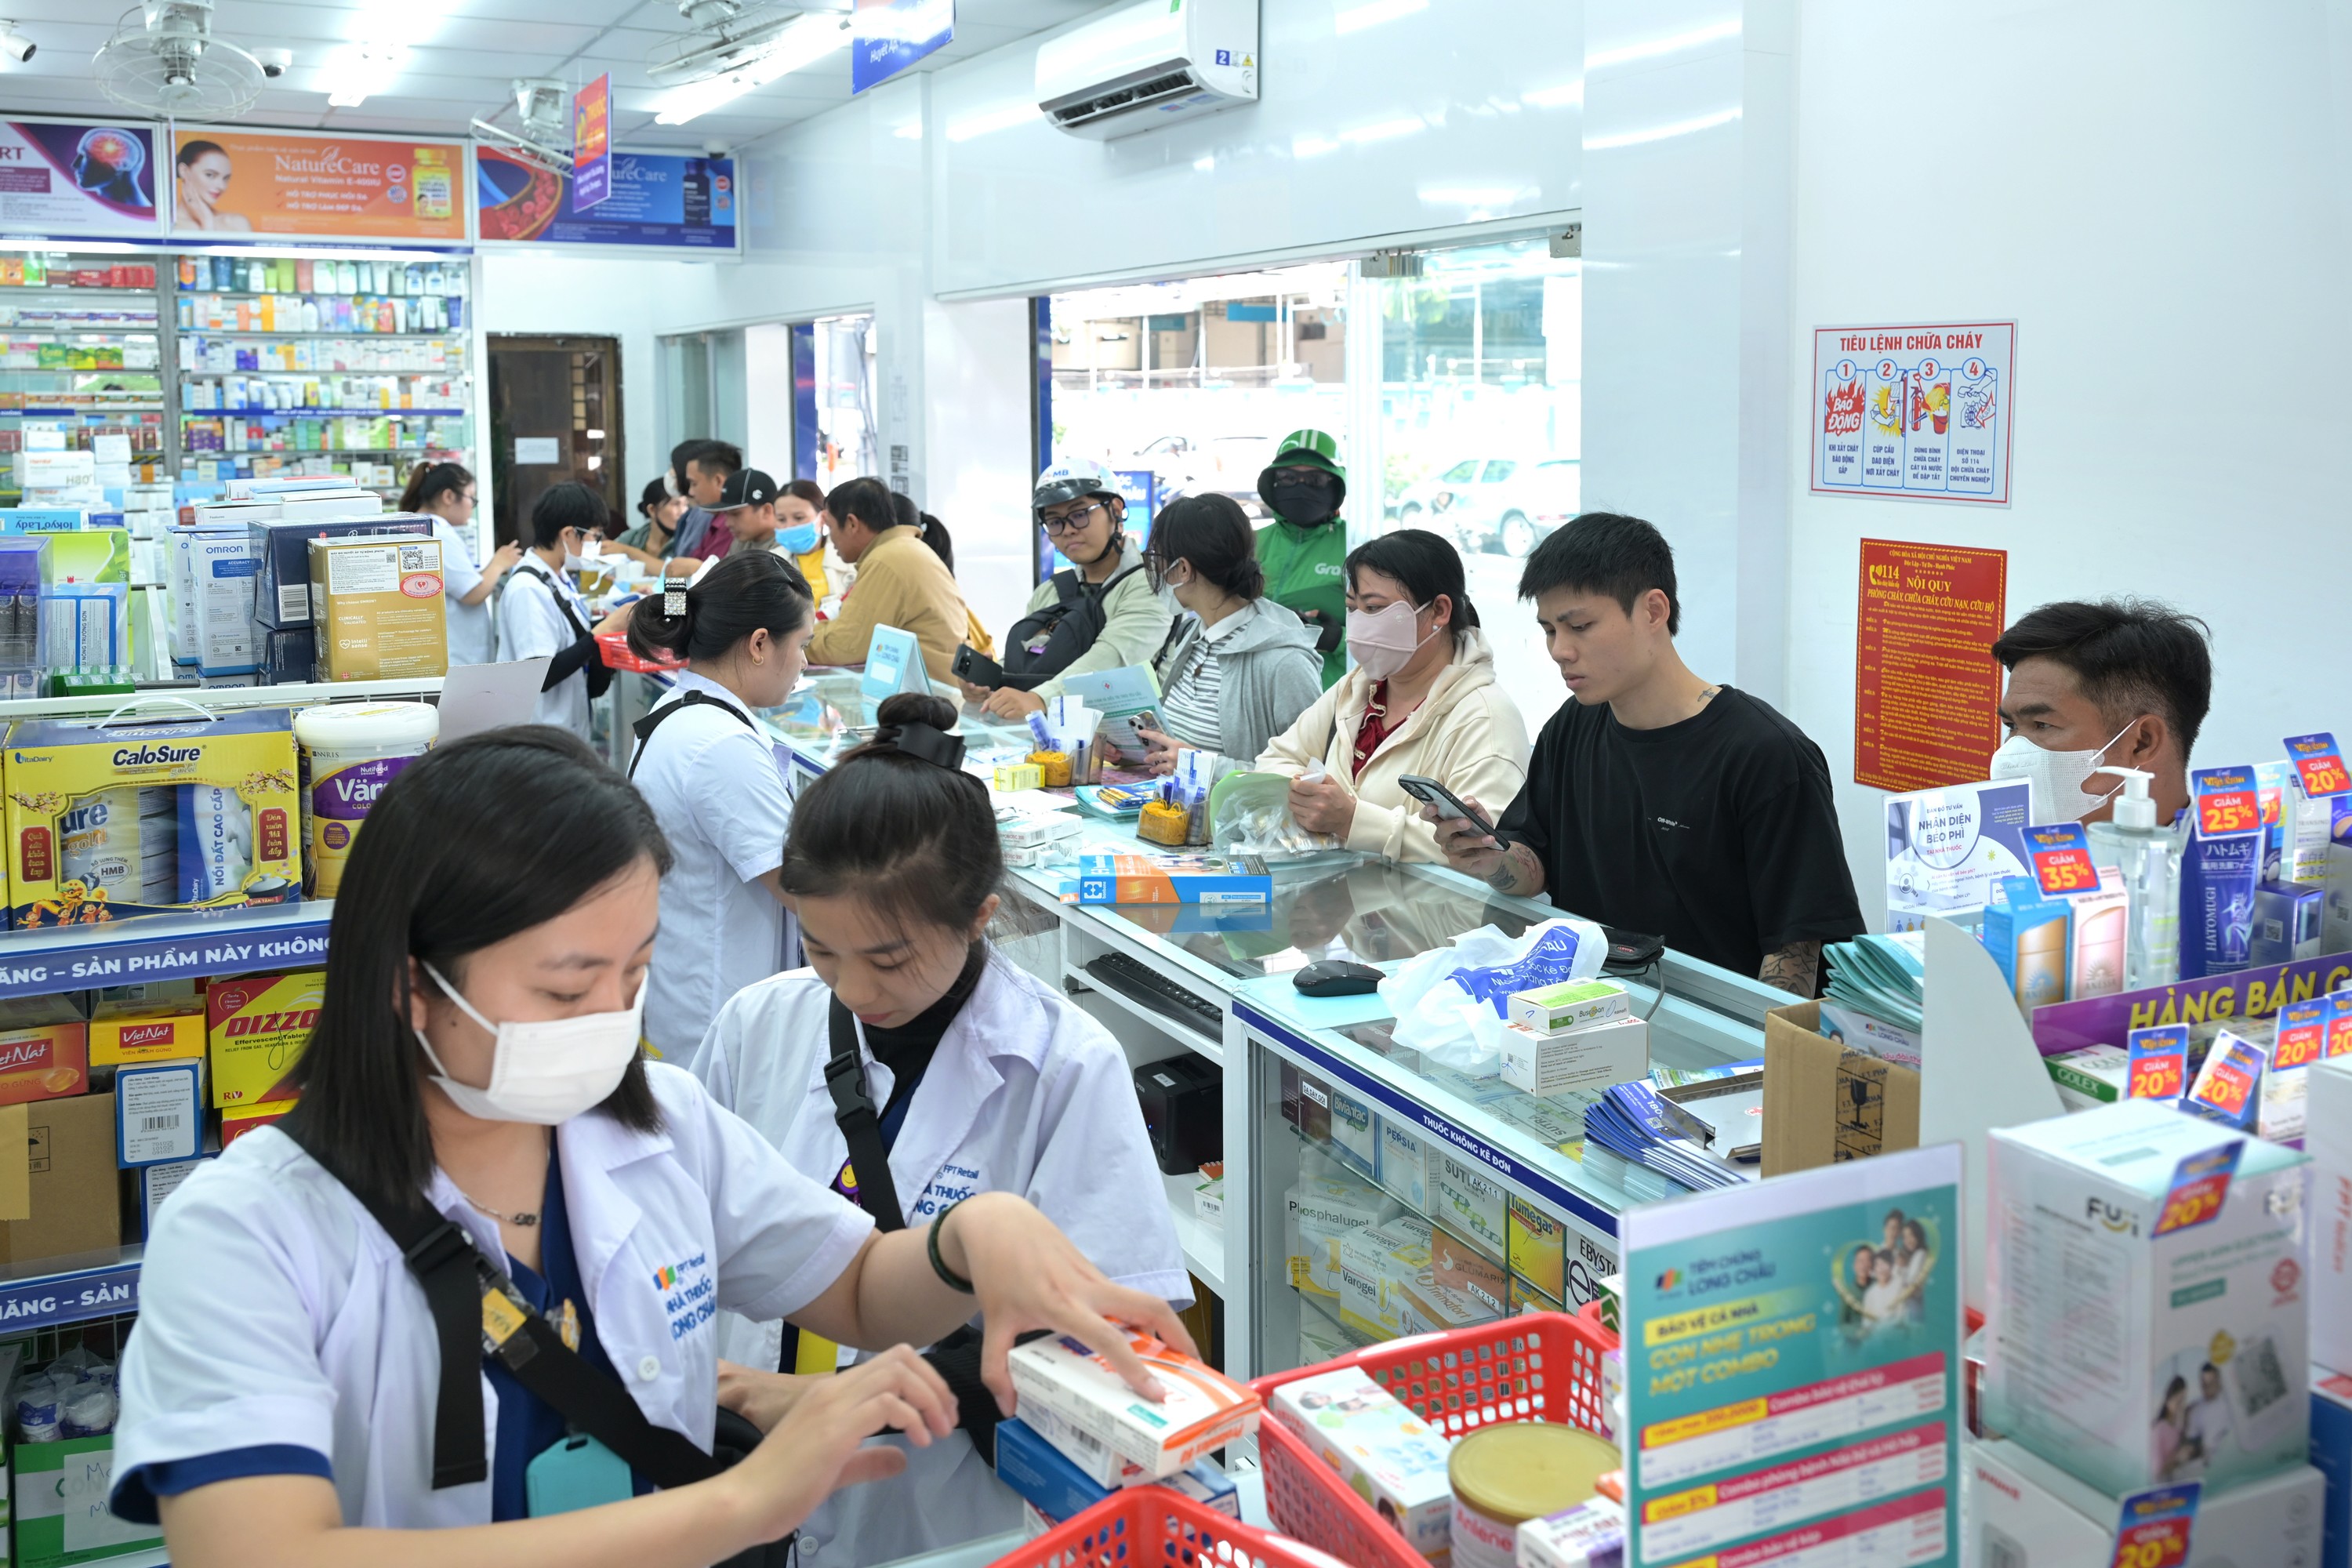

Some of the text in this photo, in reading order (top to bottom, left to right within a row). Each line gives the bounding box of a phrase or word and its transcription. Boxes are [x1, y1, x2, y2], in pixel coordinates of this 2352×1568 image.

[1218, 51, 1228, 64] 2
[275, 154, 380, 175] NatureCare
[275, 175, 345, 185] Natural Vitamin
[1840, 331, 1983, 354] TIÊU LỆNH CHỮA CHÁY
[1842, 363, 1849, 376] 1
[1882, 363, 1891, 377] 2
[1926, 363, 1933, 376] 3
[1969, 362, 1979, 376] 4
[1833, 396, 1853, 412] BÁO
[1828, 412, 1860, 432] ĐỘNG
[1847, 443, 1859, 452] CHÁY
[1883, 456, 1895, 466] ĐIỆN
[1315, 563, 1341, 575] Gra
[1882, 565, 1900, 579] 114
[1907, 575, 1951, 593] NỘI QUY
[113, 745, 200, 766] CaloSure
[2308, 760, 2332, 771] GIẢM
[2305, 768, 2345, 793] 20%
[2213, 795, 2241, 808] GIẢM
[214, 814, 223, 837] CAO
[1948, 813, 1971, 827] DIỆN
[2205, 804, 2253, 830] 25%
[1948, 827, 1965, 840] PHÌ
[2048, 853, 2076, 866] GIẢM
[2206, 842, 2251, 857] ハトムギ
[101, 866, 125, 876] HMB
[2043, 863, 2089, 890] 35%
[2205, 886, 2216, 951] HATOMUGI
[71, 956, 121, 978] SẢN
[129, 946, 198, 972] PHẨM
[205, 943, 252, 964] NÀY
[2129, 985, 2234, 1029] HÀNG
[2245, 967, 2317, 1018] BÁN
[1579, 1007, 1605, 1018] Buscopan
[224, 1008, 323, 1039] DIZZO
[123, 1027, 170, 1043] VietNat
[234, 1036, 281, 1045] Effervescent
[2278, 1037, 2318, 1065] 20%
[2143, 1059, 2169, 1072] GIẢM
[2133, 1068, 2178, 1098] 20%
[2199, 1072, 2243, 1104] 20%
[1334, 1096, 1367, 1122] Biviantac
[1423, 1115, 1511, 1174] THUỐC KHÔNG KÊ ĐƠN
[943, 1164, 979, 1179] FPT Retail
[1472, 1178, 1497, 1197] AK.2.1.1
[1510, 1192, 1554, 1236] Tumegas
[2158, 1192, 2220, 1232] 20%
[1362, 1229, 1401, 1247] Varogel
[1580, 1239, 1617, 1276] EBYSTA
[1343, 1270, 1376, 1296] Varogel
[1455, 1264, 1506, 1285] GLUMARIX
[80, 1282, 130, 1307] SẢN
[1471, 1285, 1496, 1308] AK.2.1.2
[1701, 1348, 1779, 1384] COMBO
[1456, 1508, 1514, 1553] Anlene
[2119, 1537, 2184, 1568] 20%
